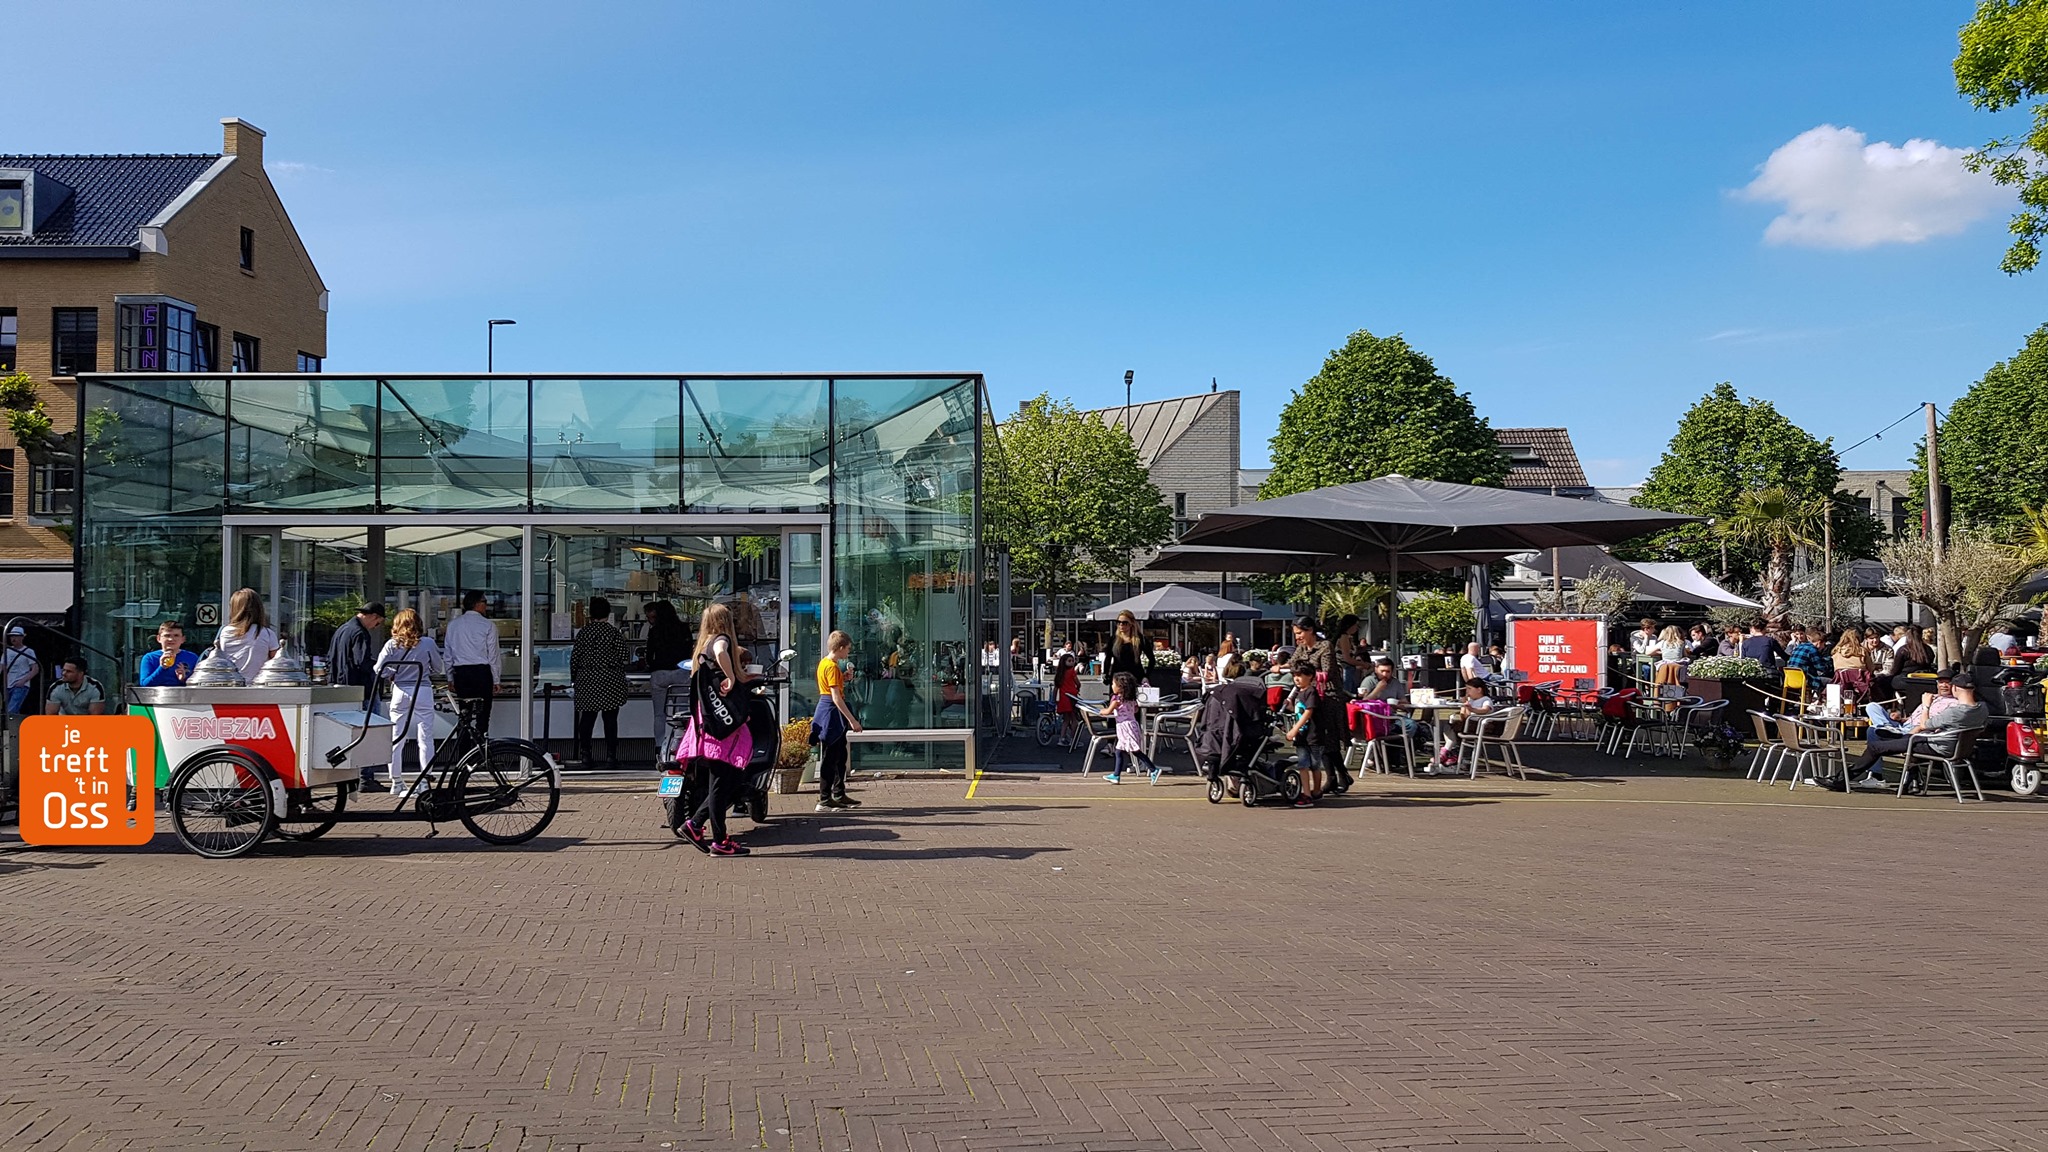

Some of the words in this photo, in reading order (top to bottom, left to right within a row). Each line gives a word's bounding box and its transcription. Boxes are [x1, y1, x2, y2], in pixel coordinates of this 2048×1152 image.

[1538, 635, 1555, 644] FIJN
[1555, 635, 1565, 644] JE
[1538, 645, 1560, 654] WEER
[1561, 645, 1572, 654] TE
[1538, 665, 1550, 673] OP
[1551, 665, 1588, 674] AFSTAND
[171, 716, 277, 741] VENEZIA
